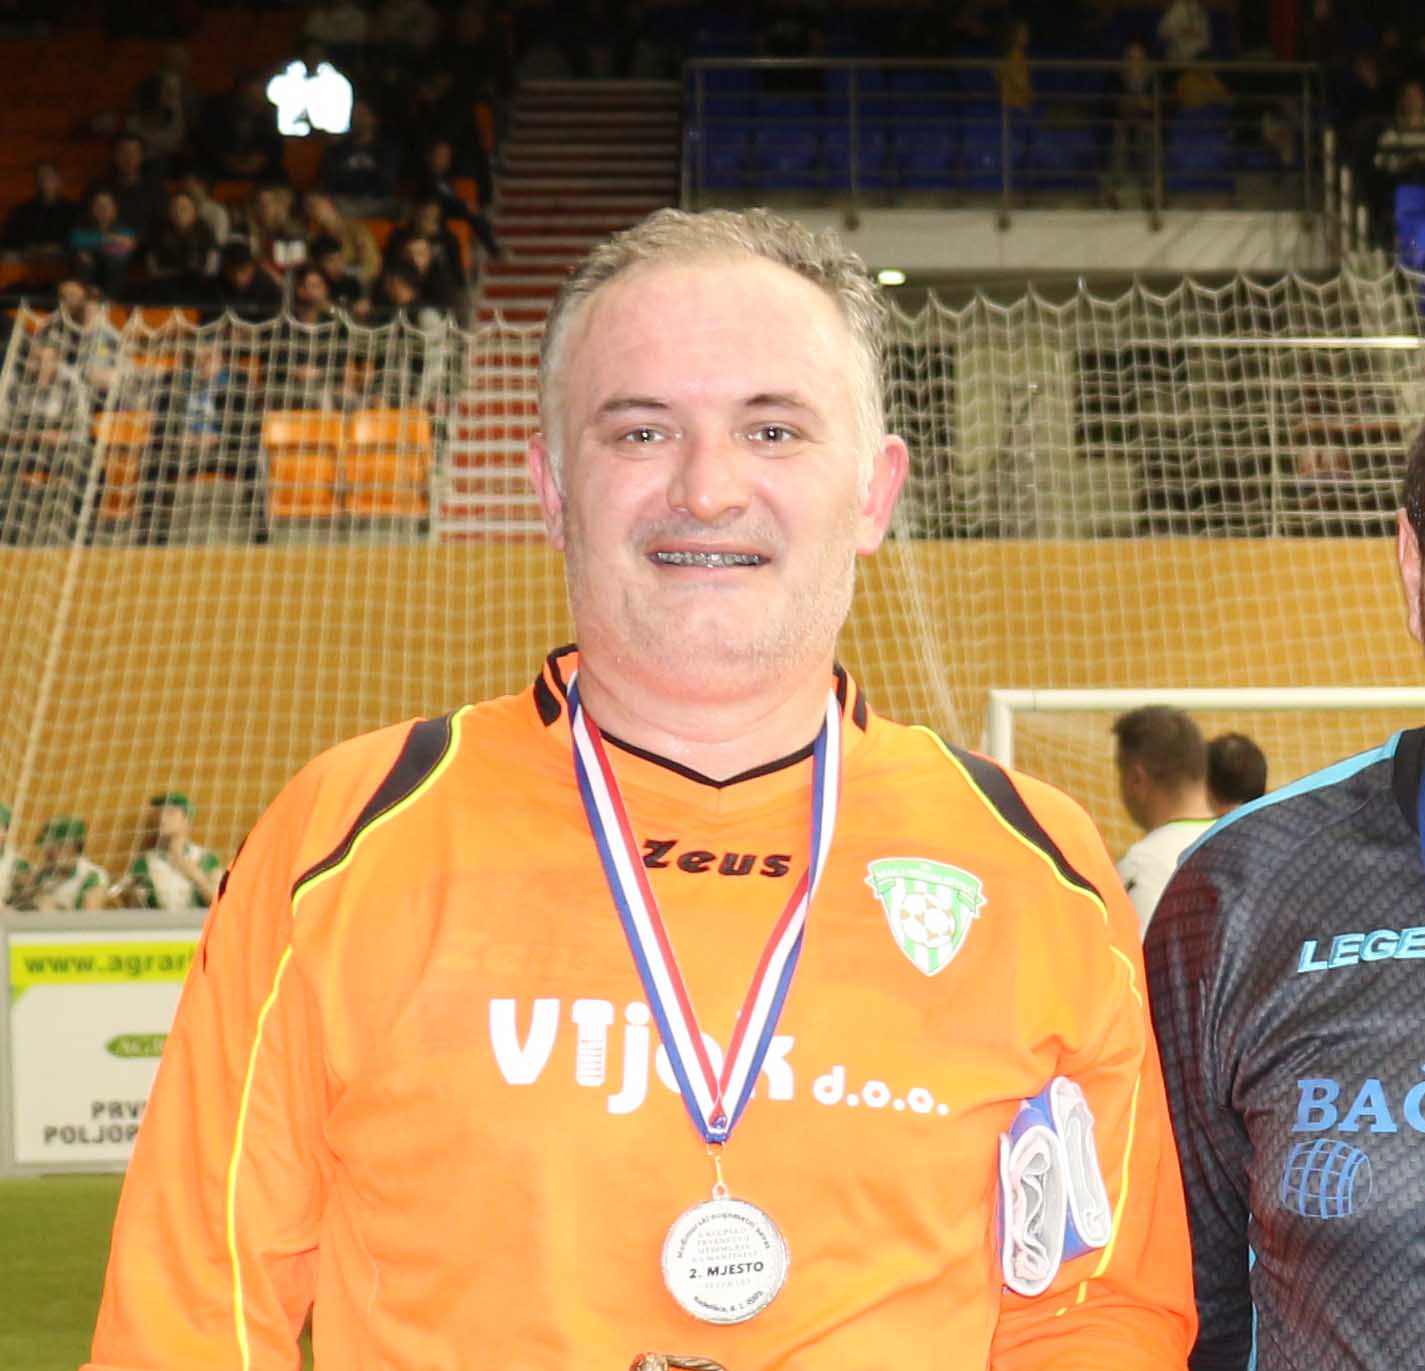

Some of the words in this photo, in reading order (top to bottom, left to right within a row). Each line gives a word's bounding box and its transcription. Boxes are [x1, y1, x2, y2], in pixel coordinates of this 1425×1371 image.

[642, 838, 792, 878] Zeus
[812, 1065, 949, 1116] d.o.o.
[706, 1261, 764, 1277] MJESTO
